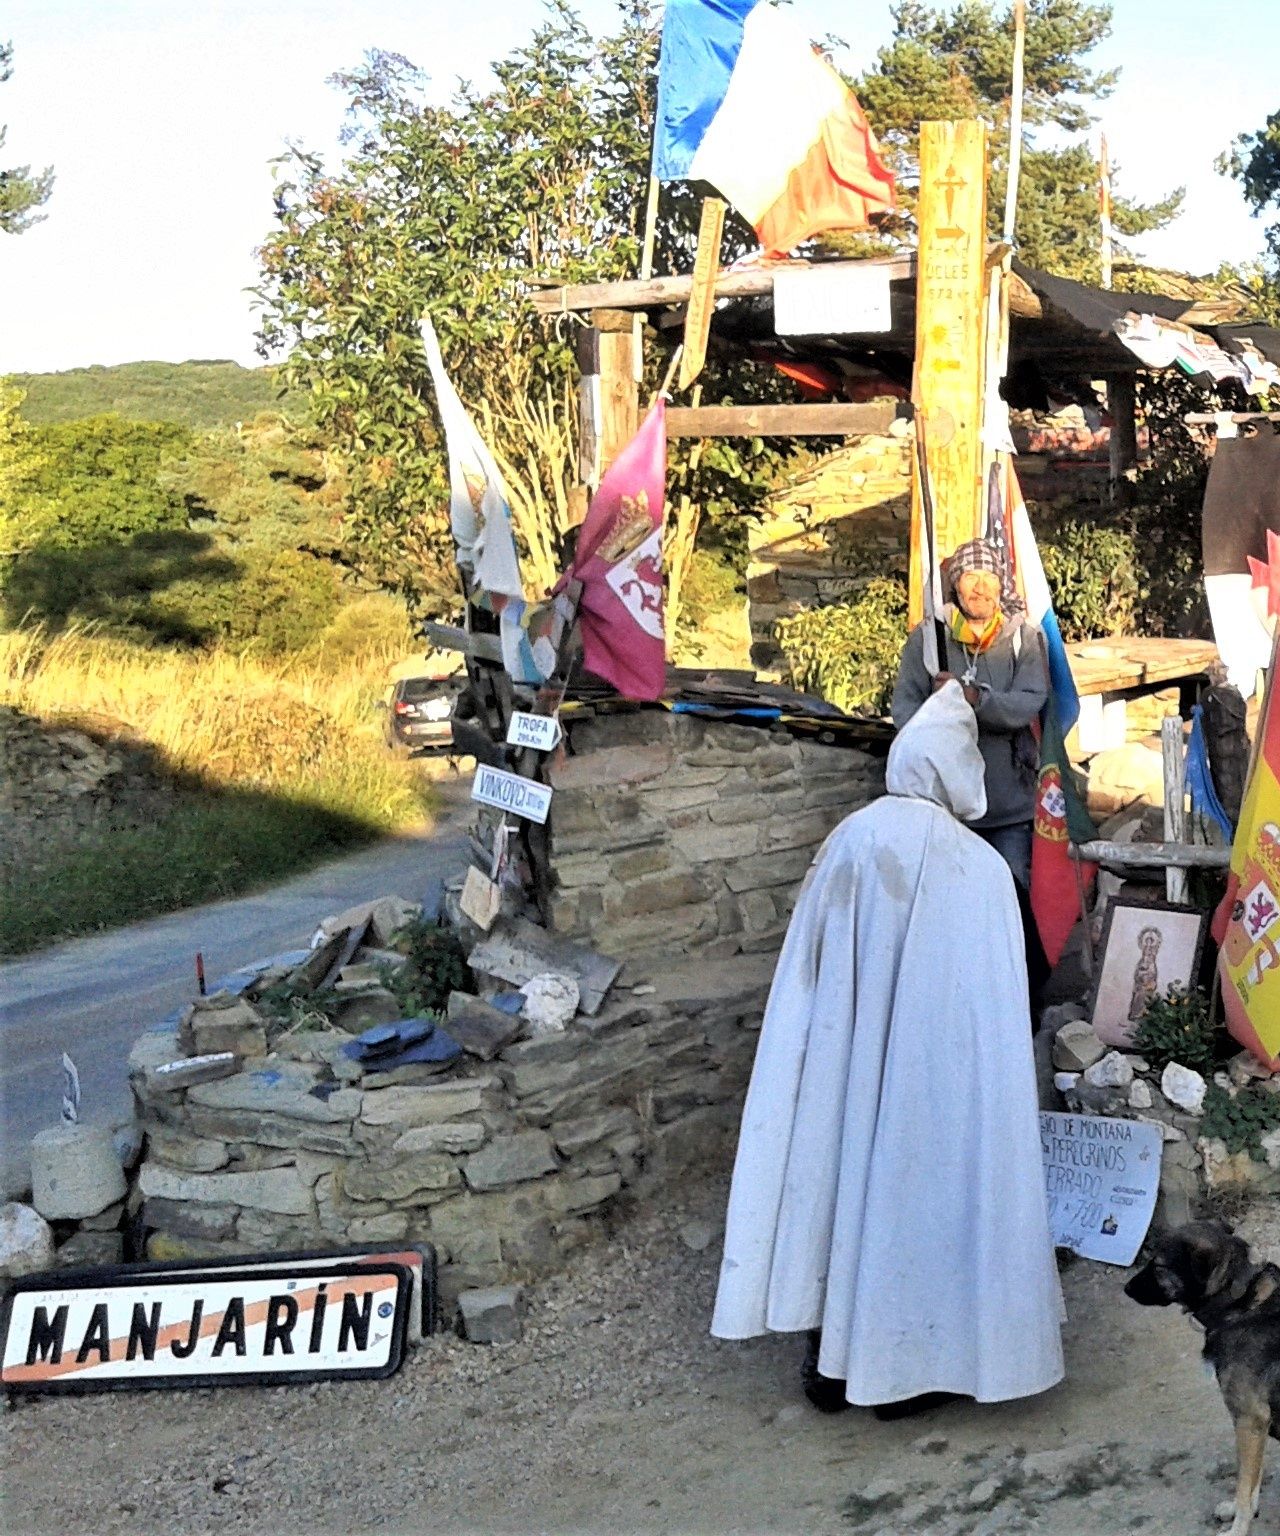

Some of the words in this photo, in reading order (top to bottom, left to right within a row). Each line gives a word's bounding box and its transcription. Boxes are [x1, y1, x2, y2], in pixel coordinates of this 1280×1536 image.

[517, 715, 549, 734] TROFA
[1063, 1118, 1075, 1137] DE
[1080, 1119, 1133, 1142] MONTAÑA
